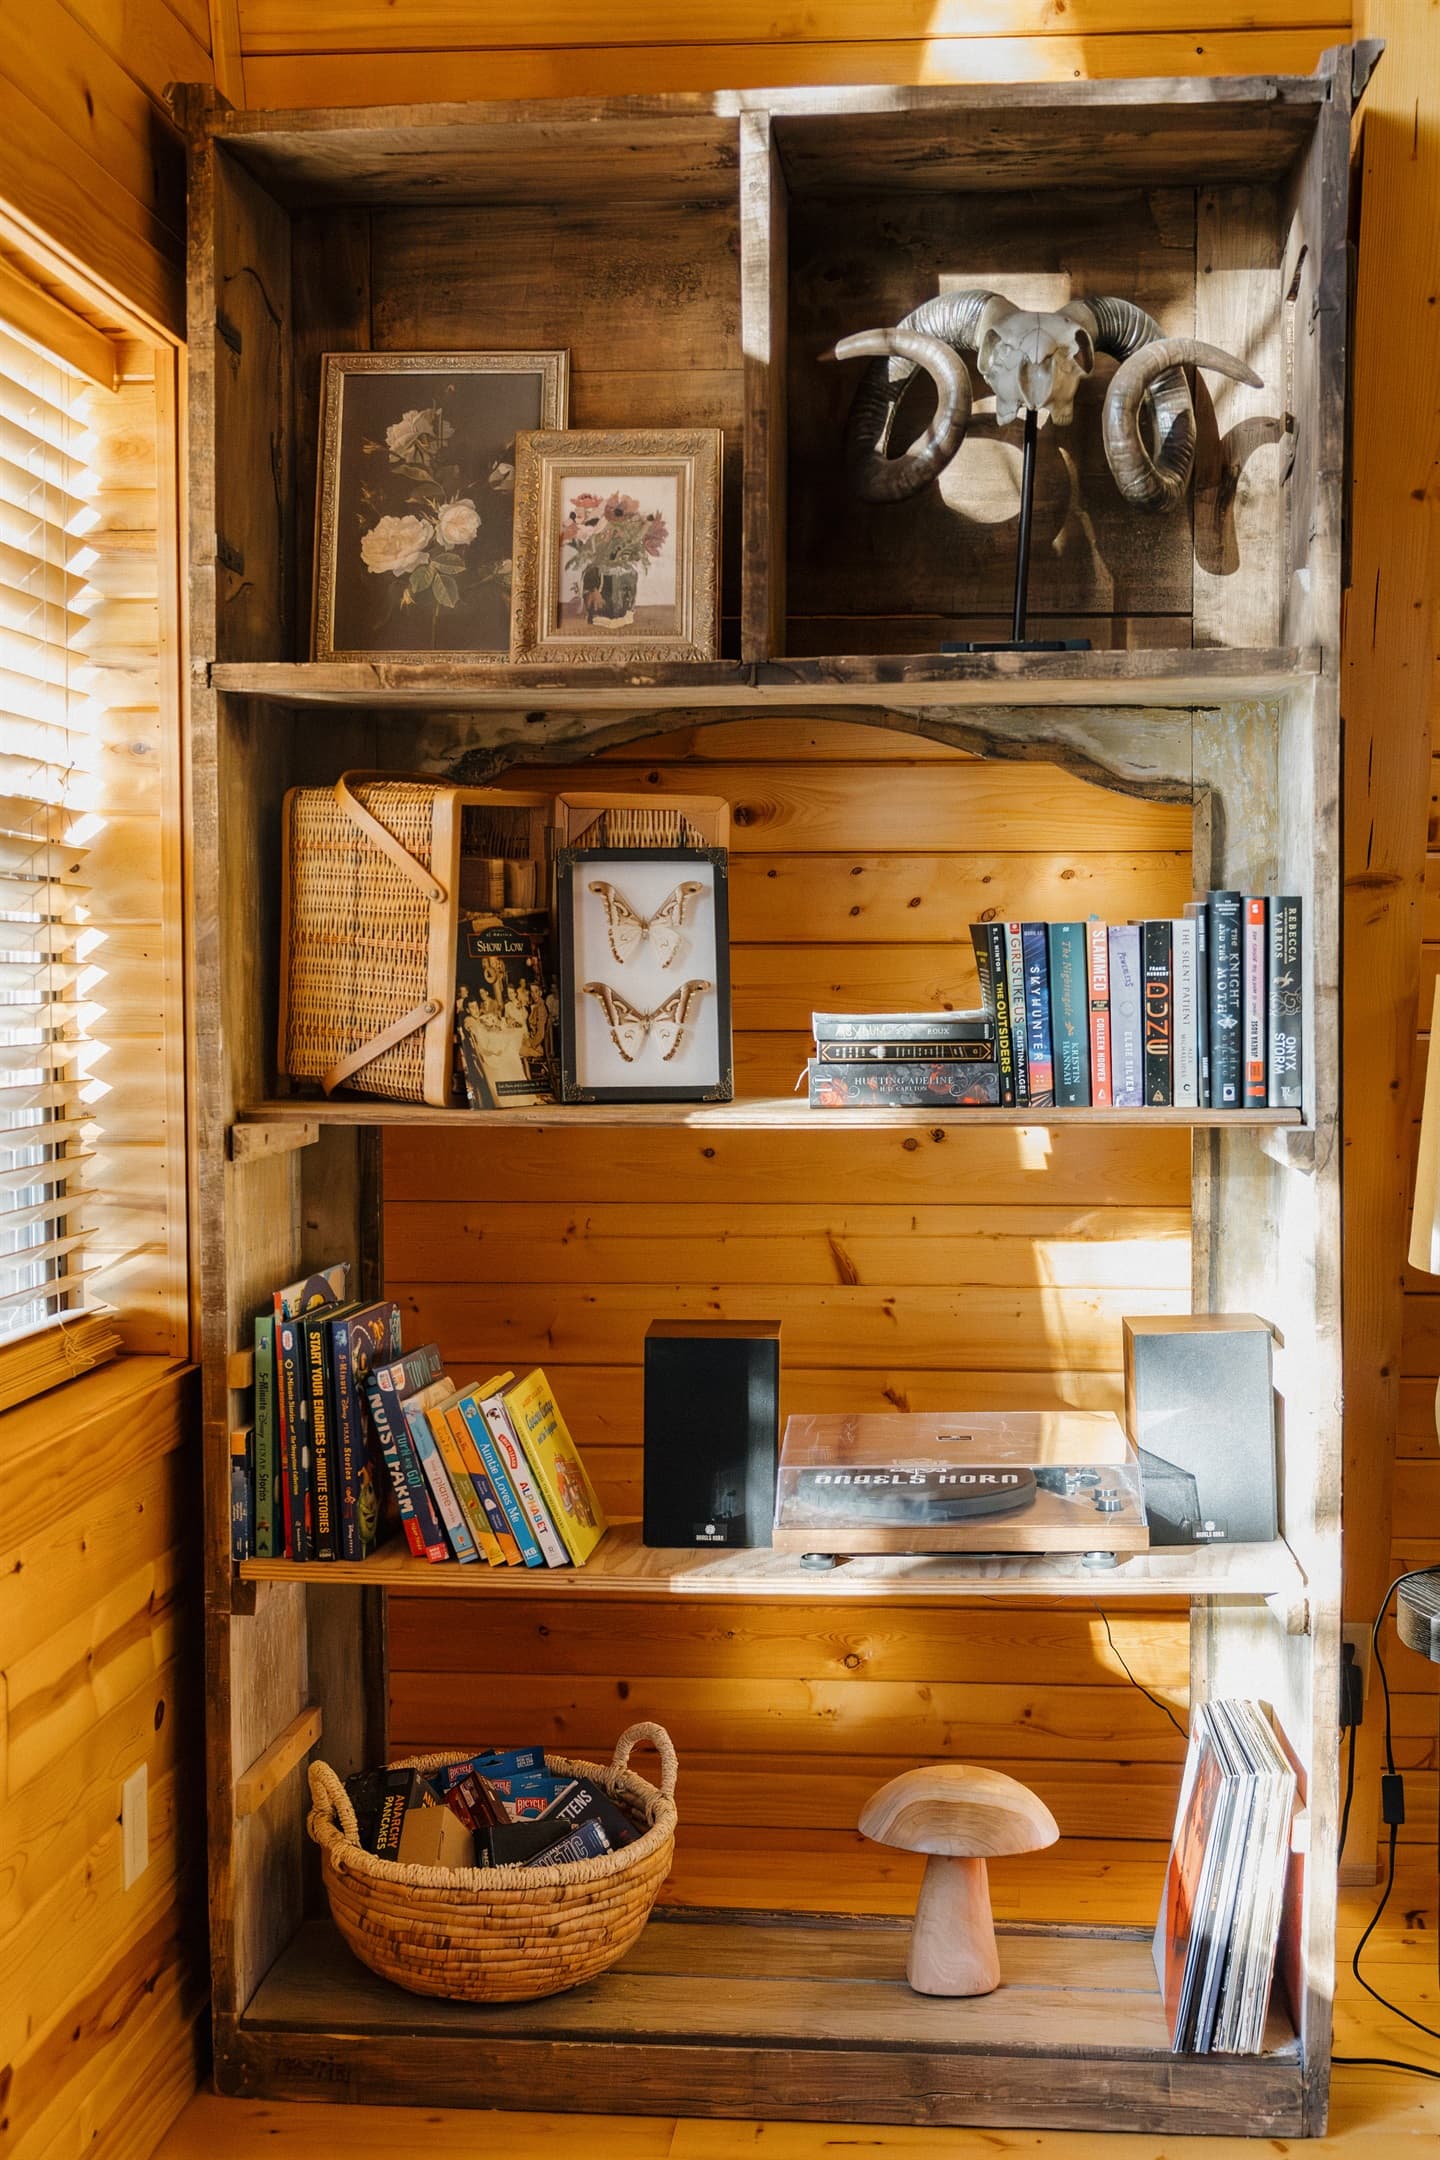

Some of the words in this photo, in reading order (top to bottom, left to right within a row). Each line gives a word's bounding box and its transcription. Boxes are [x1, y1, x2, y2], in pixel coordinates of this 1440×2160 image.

[1062, 940, 1072, 959] The
[1182, 928, 1190, 946] THE
[1218, 924, 1226, 942] AND
[1274, 912, 1284, 960] YARROS
[1288, 908, 1297, 963] REBECCA
[994, 945, 1002, 972] HINTON
[1010, 937, 1023, 974] GIRLS
[1092, 930, 1106, 992] SLAMMED
[1182, 950, 1190, 982] SILENT
[1218, 944, 1226, 962] THE
[996, 982, 1004, 1000] THE
[1012, 978, 1024, 1003] LIKE
[1060, 962, 1073, 1017] Nightingale
[1216, 967, 1226, 1014] MOTH
[1230, 952, 1240, 1008] KNIGHT
[1014, 1006, 1024, 1024] US
[1030, 966, 1044, 1061] SKYHUNTER
[1182, 986, 1191, 1026] PATIENT
[997, 1000, 1011, 1074] OUTSIDERS
[1016, 1029, 1024, 1068] CRISTINA
[1096, 1018, 1106, 1050] COLLEEN
[1124, 1032, 1133, 1056] ELSIE
[1062, 1040, 1072, 1085] HANNAH
[1071, 1042, 1080, 1084] KRISTIN
[1096, 1052, 1106, 1082] HOOVER
[1274, 1032, 1286, 1074] STORM
[1284, 1036, 1296, 1070] ONYX
[854, 1076, 905, 1086] HUNTING
[910, 1076, 954, 1085] ADELINE
[1018, 1069, 1026, 1095] ALGER
[1124, 1060, 1134, 1092] SILVER
[309, 1331, 322, 1365] START
[259, 1372, 269, 1410] 5-Minute
[311, 1367, 324, 1396] YOUR
[338, 1354, 348, 1395] 5-Minute
[312, 1399, 325, 1446] ENGINES
[343, 1422, 351, 1444] PIXAR
[315, 1447, 328, 1492] 5-MINUTE
[343, 1447, 353, 1480] Stories
[939, 1474, 1018, 1484] HORN
[258, 1473, 269, 1502] Stories
[432, 1476, 451, 1506] plane
[480, 1443, 500, 1474] Auntie
[494, 1470, 512, 1506] Loves
[506, 1506, 519, 1524] Me
[318, 1495, 330, 1534] STORIES
[519, 1482, 548, 1534] ALPHABET
[448, 1764, 474, 1782] BICYCLE
[376, 1796, 394, 1850] PANCAKES
[387, 1794, 405, 1848] ANARCHY
[517, 1800, 546, 1812] BICYCLE
